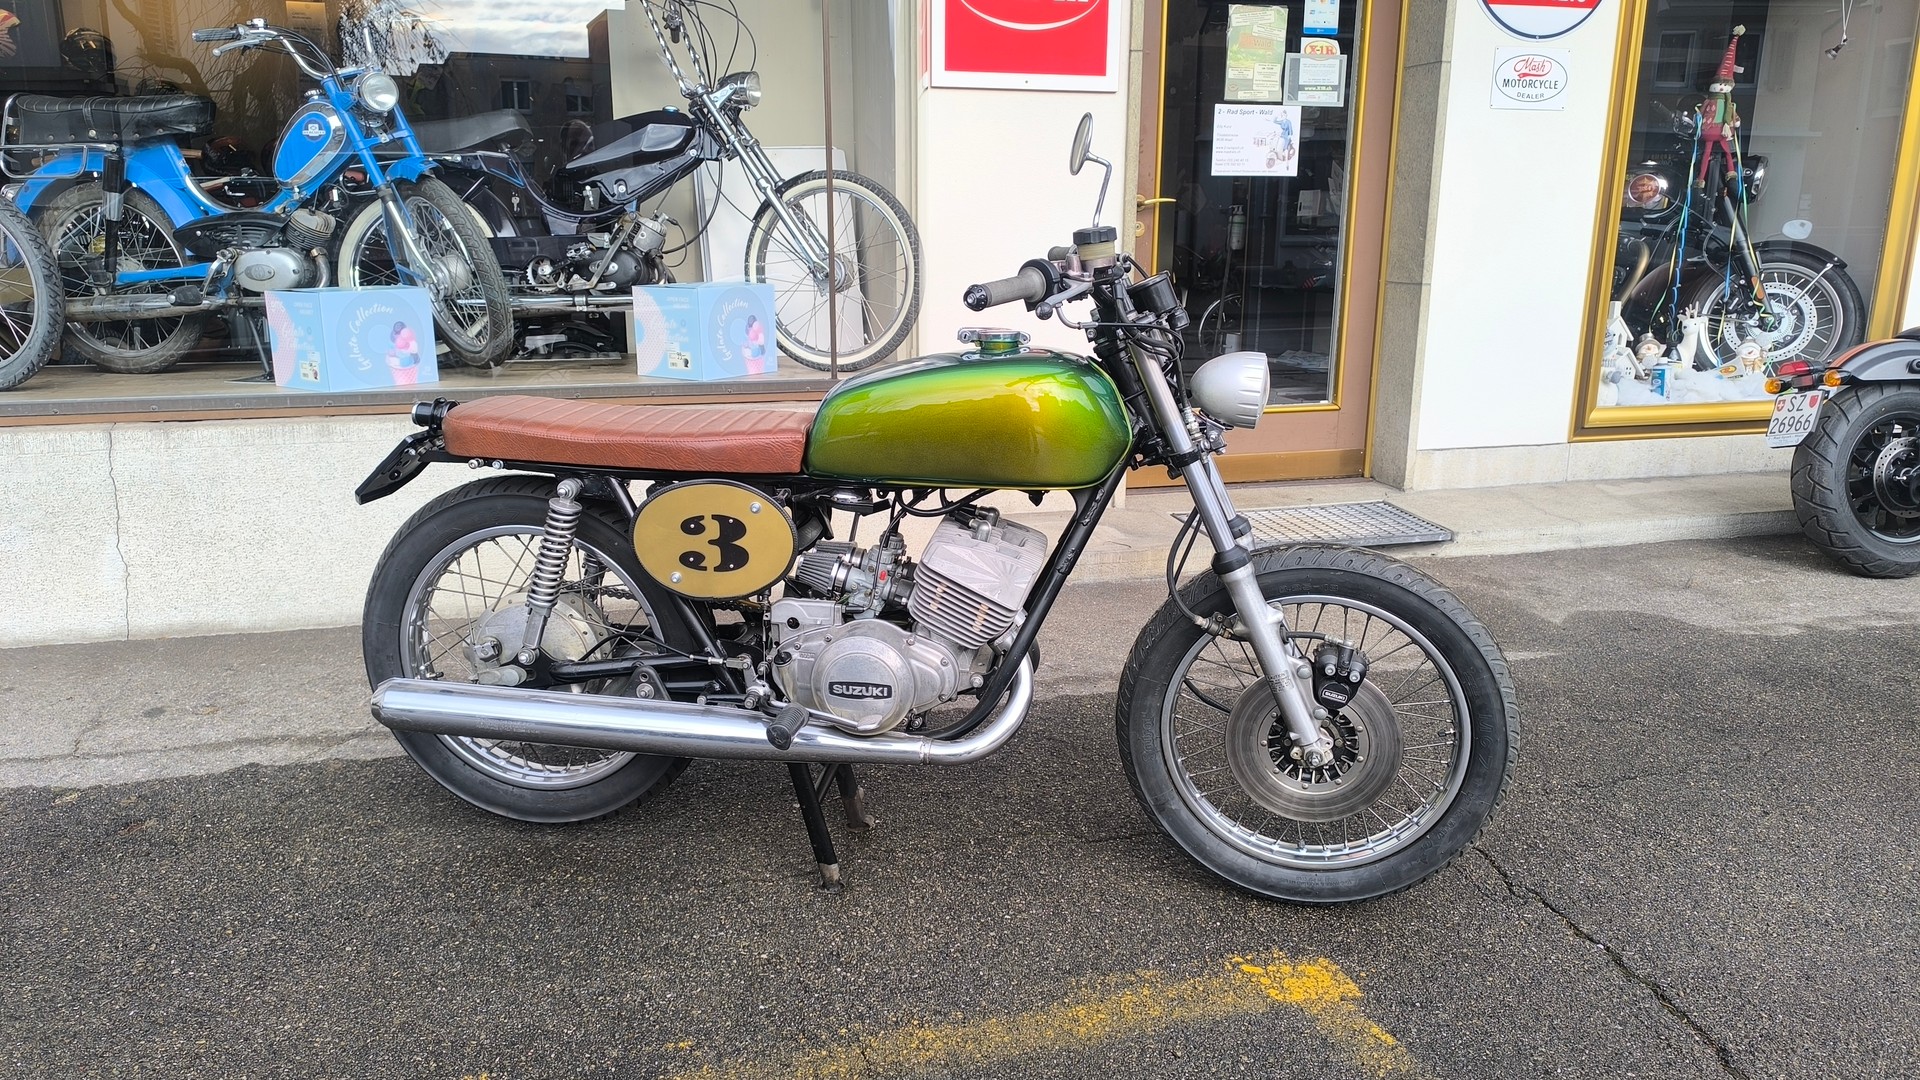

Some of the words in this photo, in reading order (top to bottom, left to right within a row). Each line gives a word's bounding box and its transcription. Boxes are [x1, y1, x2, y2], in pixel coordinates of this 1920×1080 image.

[1514, 57, 1553, 78] Mash
[1502, 78, 1559, 90] MOTORCYCLE
[1516, 91, 1545, 100] DEALER
[350, 303, 394, 335] Collection
[718, 298, 749, 327] Collection
[1787, 394, 1808, 413] SZ
[1769, 413, 1813, 435] 26966
[679, 514, 749, 573] 3
[832, 683, 889, 697] SUZUKI
[1324, 691, 1347, 701] SUZUKI
